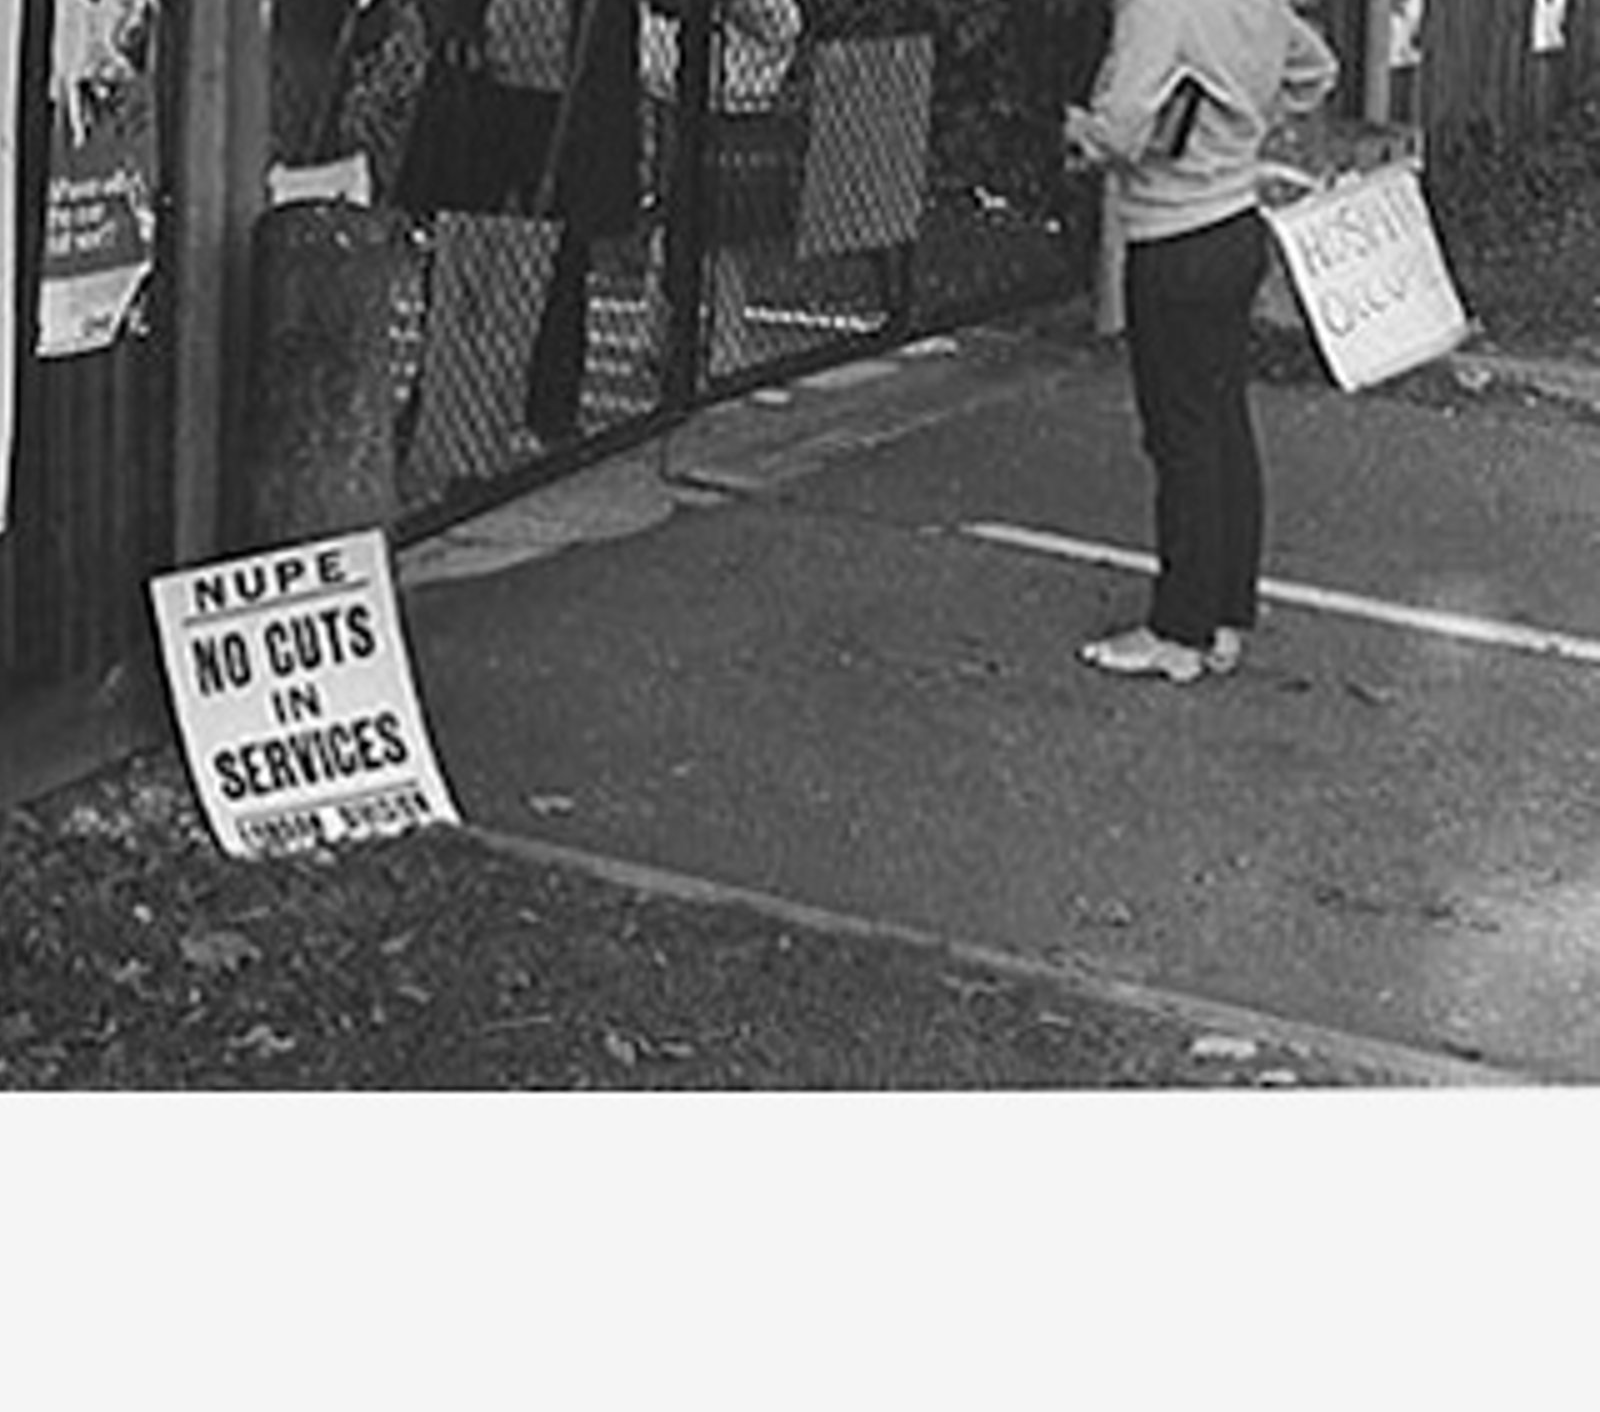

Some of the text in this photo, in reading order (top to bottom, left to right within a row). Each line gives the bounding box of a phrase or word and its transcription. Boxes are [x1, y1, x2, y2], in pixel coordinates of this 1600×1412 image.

[192, 548, 348, 614] NUPE
[192, 603, 377, 696] NO CUTS
[270, 680, 323, 726] IN
[212, 709, 409, 802] SERVICES
